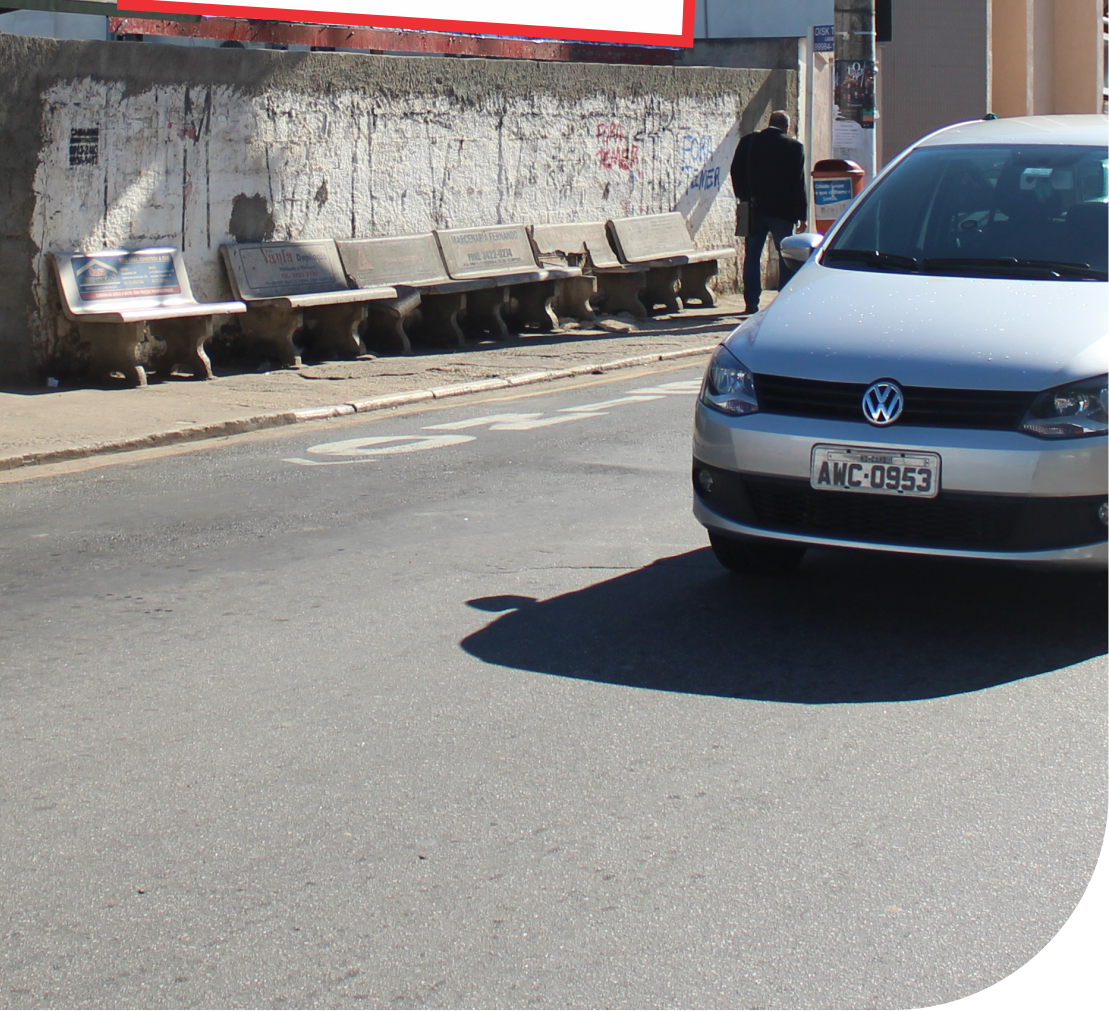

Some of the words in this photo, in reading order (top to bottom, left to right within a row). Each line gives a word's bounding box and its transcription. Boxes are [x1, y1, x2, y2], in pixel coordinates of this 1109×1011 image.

[815, 27, 830, 36] DISK
[682, 165, 720, 195] TEMER
[451, 232, 489, 244] MARCENARIA
[489, 230, 518, 241] FERNANDO
